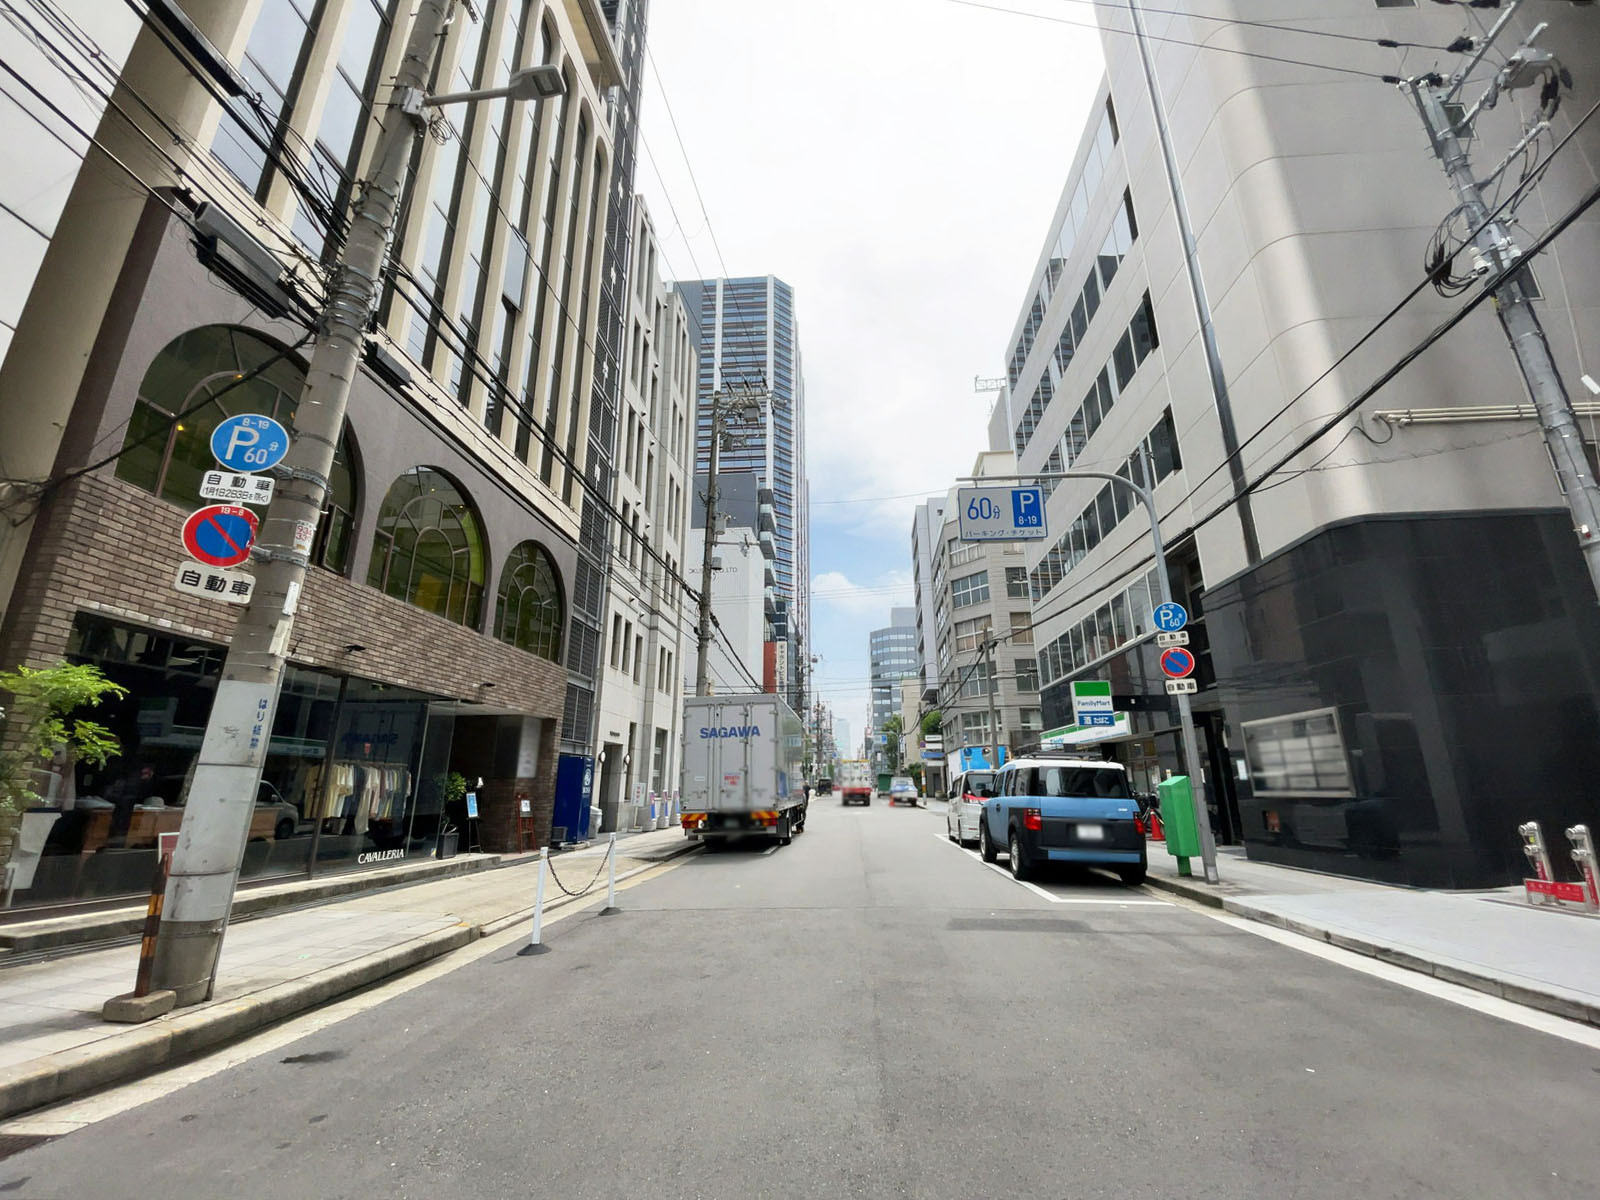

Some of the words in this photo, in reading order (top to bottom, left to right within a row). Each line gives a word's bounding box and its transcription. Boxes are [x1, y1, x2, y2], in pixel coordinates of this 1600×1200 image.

[242, 417, 270, 430] 8-19
[225, 425, 260, 460] P
[207, 474, 272, 491] 自動車
[967, 497, 1001, 520] 60分
[1019, 492, 1034, 513] P
[1018, 515, 1037, 525] 8-19
[180, 570, 252, 597] 自動車
[1160, 609, 1173, 628] P
[1077, 700, 1111, 708] FamilyMart
[699, 725, 761, 739] SAGAWA
[357, 848, 405, 865] CAVALLERIA
